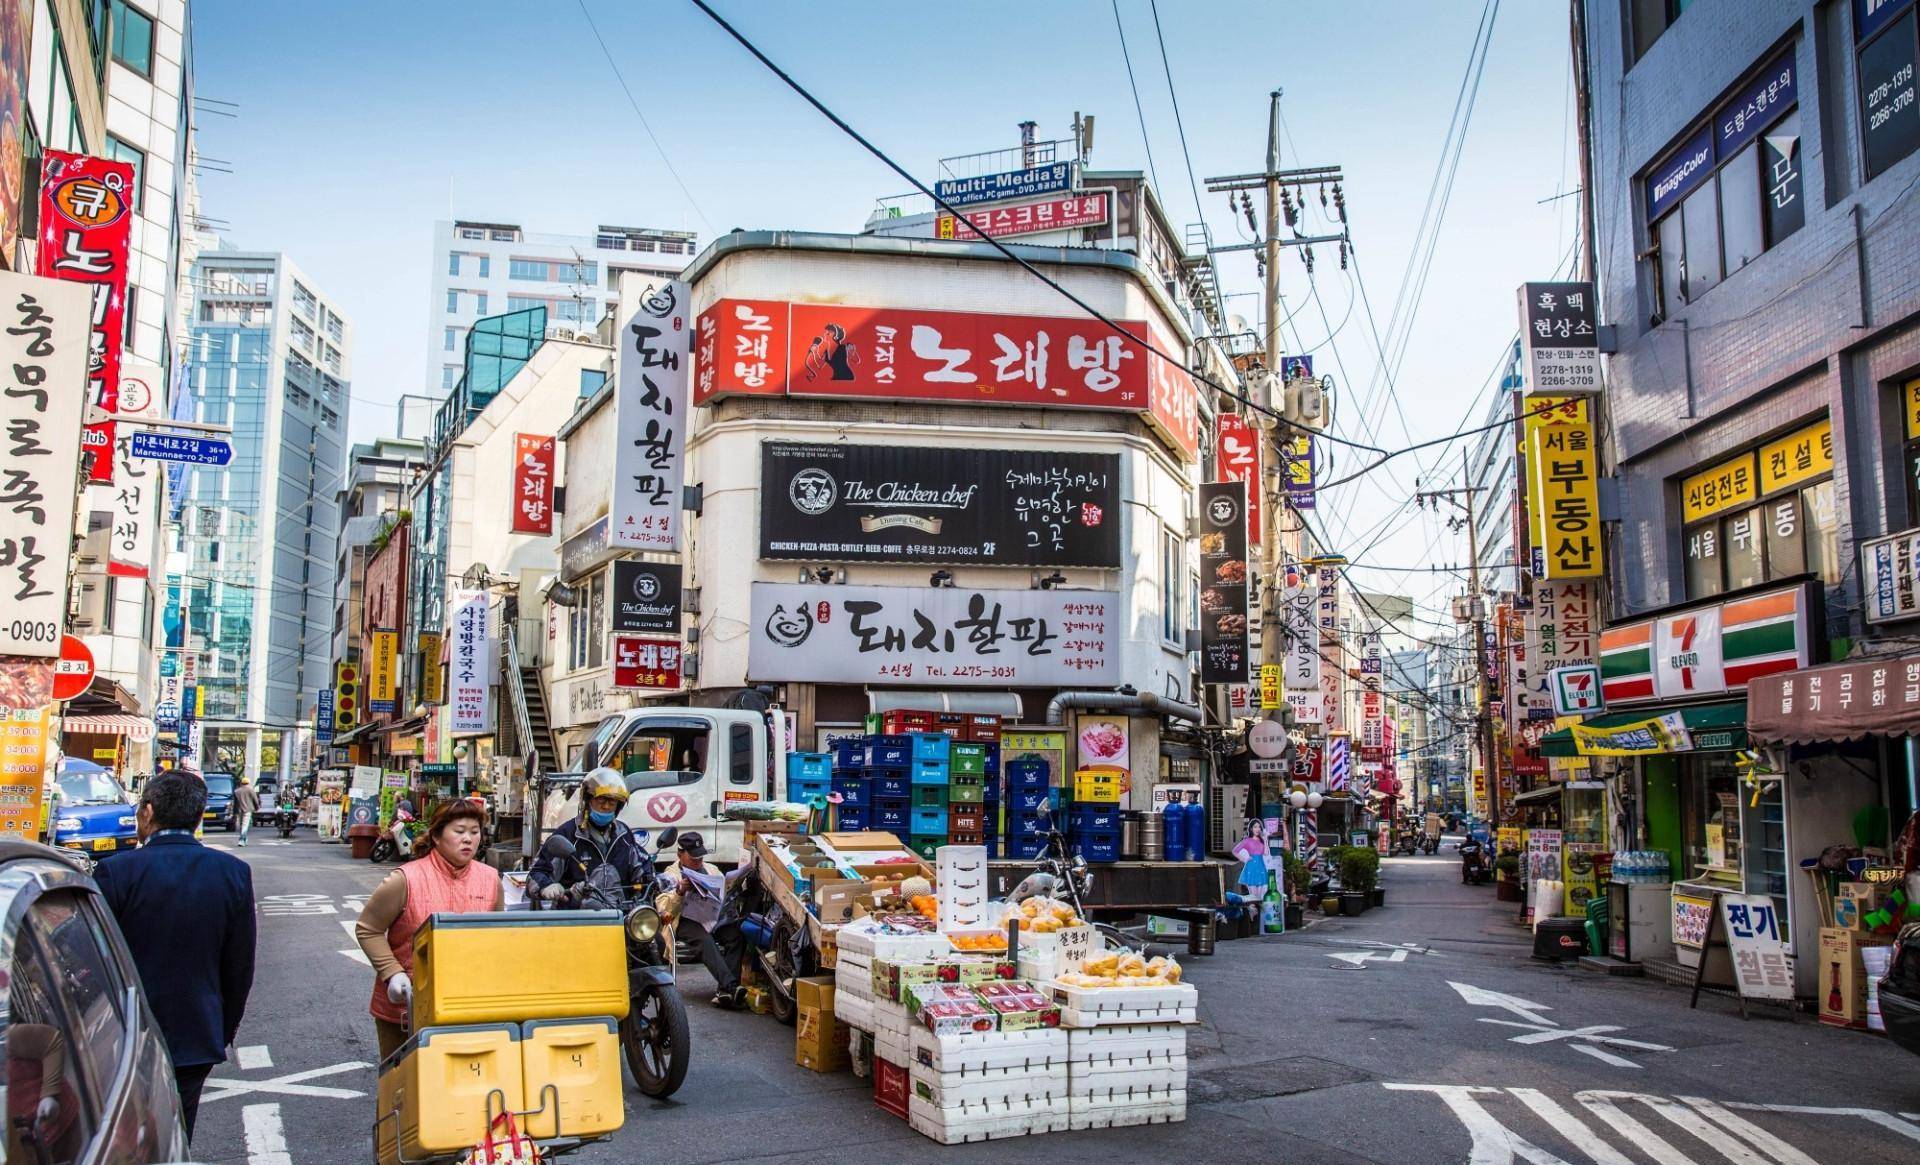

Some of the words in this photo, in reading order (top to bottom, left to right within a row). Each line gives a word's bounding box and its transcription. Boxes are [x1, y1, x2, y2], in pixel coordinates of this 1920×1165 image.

[1868, 64, 1912, 107] 2278-1319
[1870, 88, 1914, 129] 2266-3709
[104, 172, 124, 193] Q
[942, 169, 1050, 196] Multi-Media
[1053, 165, 1066, 180] 방
[67, 184, 108, 219] 큐
[955, 204, 1053, 232] 실크스크린
[1062, 197, 1100, 217] 인쇄
[1534, 318, 1594, 338] 현상소
[700, 316, 715, 393] 노래방
[734, 304, 774, 387] 노래방
[875, 325, 897, 384] 코러스
[912, 325, 1135, 392] 노래방
[1540, 365, 1593, 374] 2278-1319
[1541, 376, 1594, 385] 2266-3709
[1121, 391, 1136, 401] 3F
[632, 324, 679, 507] 돼지한판
[135, 447, 196, 462] Mareunnae-ro
[198, 455, 218, 464] 2-gil
[1545, 430, 1588, 451] 서울
[522, 453, 548, 522] 노래방
[843, 481, 873, 499] The
[876, 482, 939, 503] Chicken
[941, 484, 978, 509] chef
[1006, 467, 1106, 493] 수제마늘치킨이
[1688, 467, 1748, 511] 식당전문
[1014, 492, 1077, 523] 유명한
[1549, 460, 1595, 571] 부동산
[937, 545, 978, 555] 2274-0824
[983, 542, 996, 555] 2F
[1027, 531, 1041, 547] 그
[1050, 524, 1064, 551] 곳
[1690, 530, 1715, 560] 서울
[622, 602, 635, 612] The
[1538, 588, 1554, 620] 전기
[844, 593, 1058, 656] 돼지한판
[1062, 622, 1104, 634] 갈매기살
[1560, 583, 1590, 657] 서신전기
[460, 606, 476, 683] 사랑방칼국수
[1540, 624, 1556, 656] 열쇠
[54, 661, 85, 672] 금지
[617, 644, 679, 670] 노래방
[927, 665, 946, 677] Tel.
[953, 666, 1016, 678] 2275-3031
[1671, 652, 1698, 669] ELEVEN
[1263, 677, 1278, 702] 모텔
[1568, 689, 1595, 700] ELEVEN
[1782, 680, 1794, 714] 철물
[1809, 677, 1822, 712] 전기
[1839, 673, 1853, 710] 공구
[1872, 669, 1887, 707] 잡화
[1701, 732, 1732, 748] ELEVEN
[957, 819, 975, 827] HITE
[1727, 903, 1779, 941] 전기
[1737, 950, 1787, 987] 철물
[469, 1062, 481, 1077] 4
[571, 1053, 582, 1068] 4
